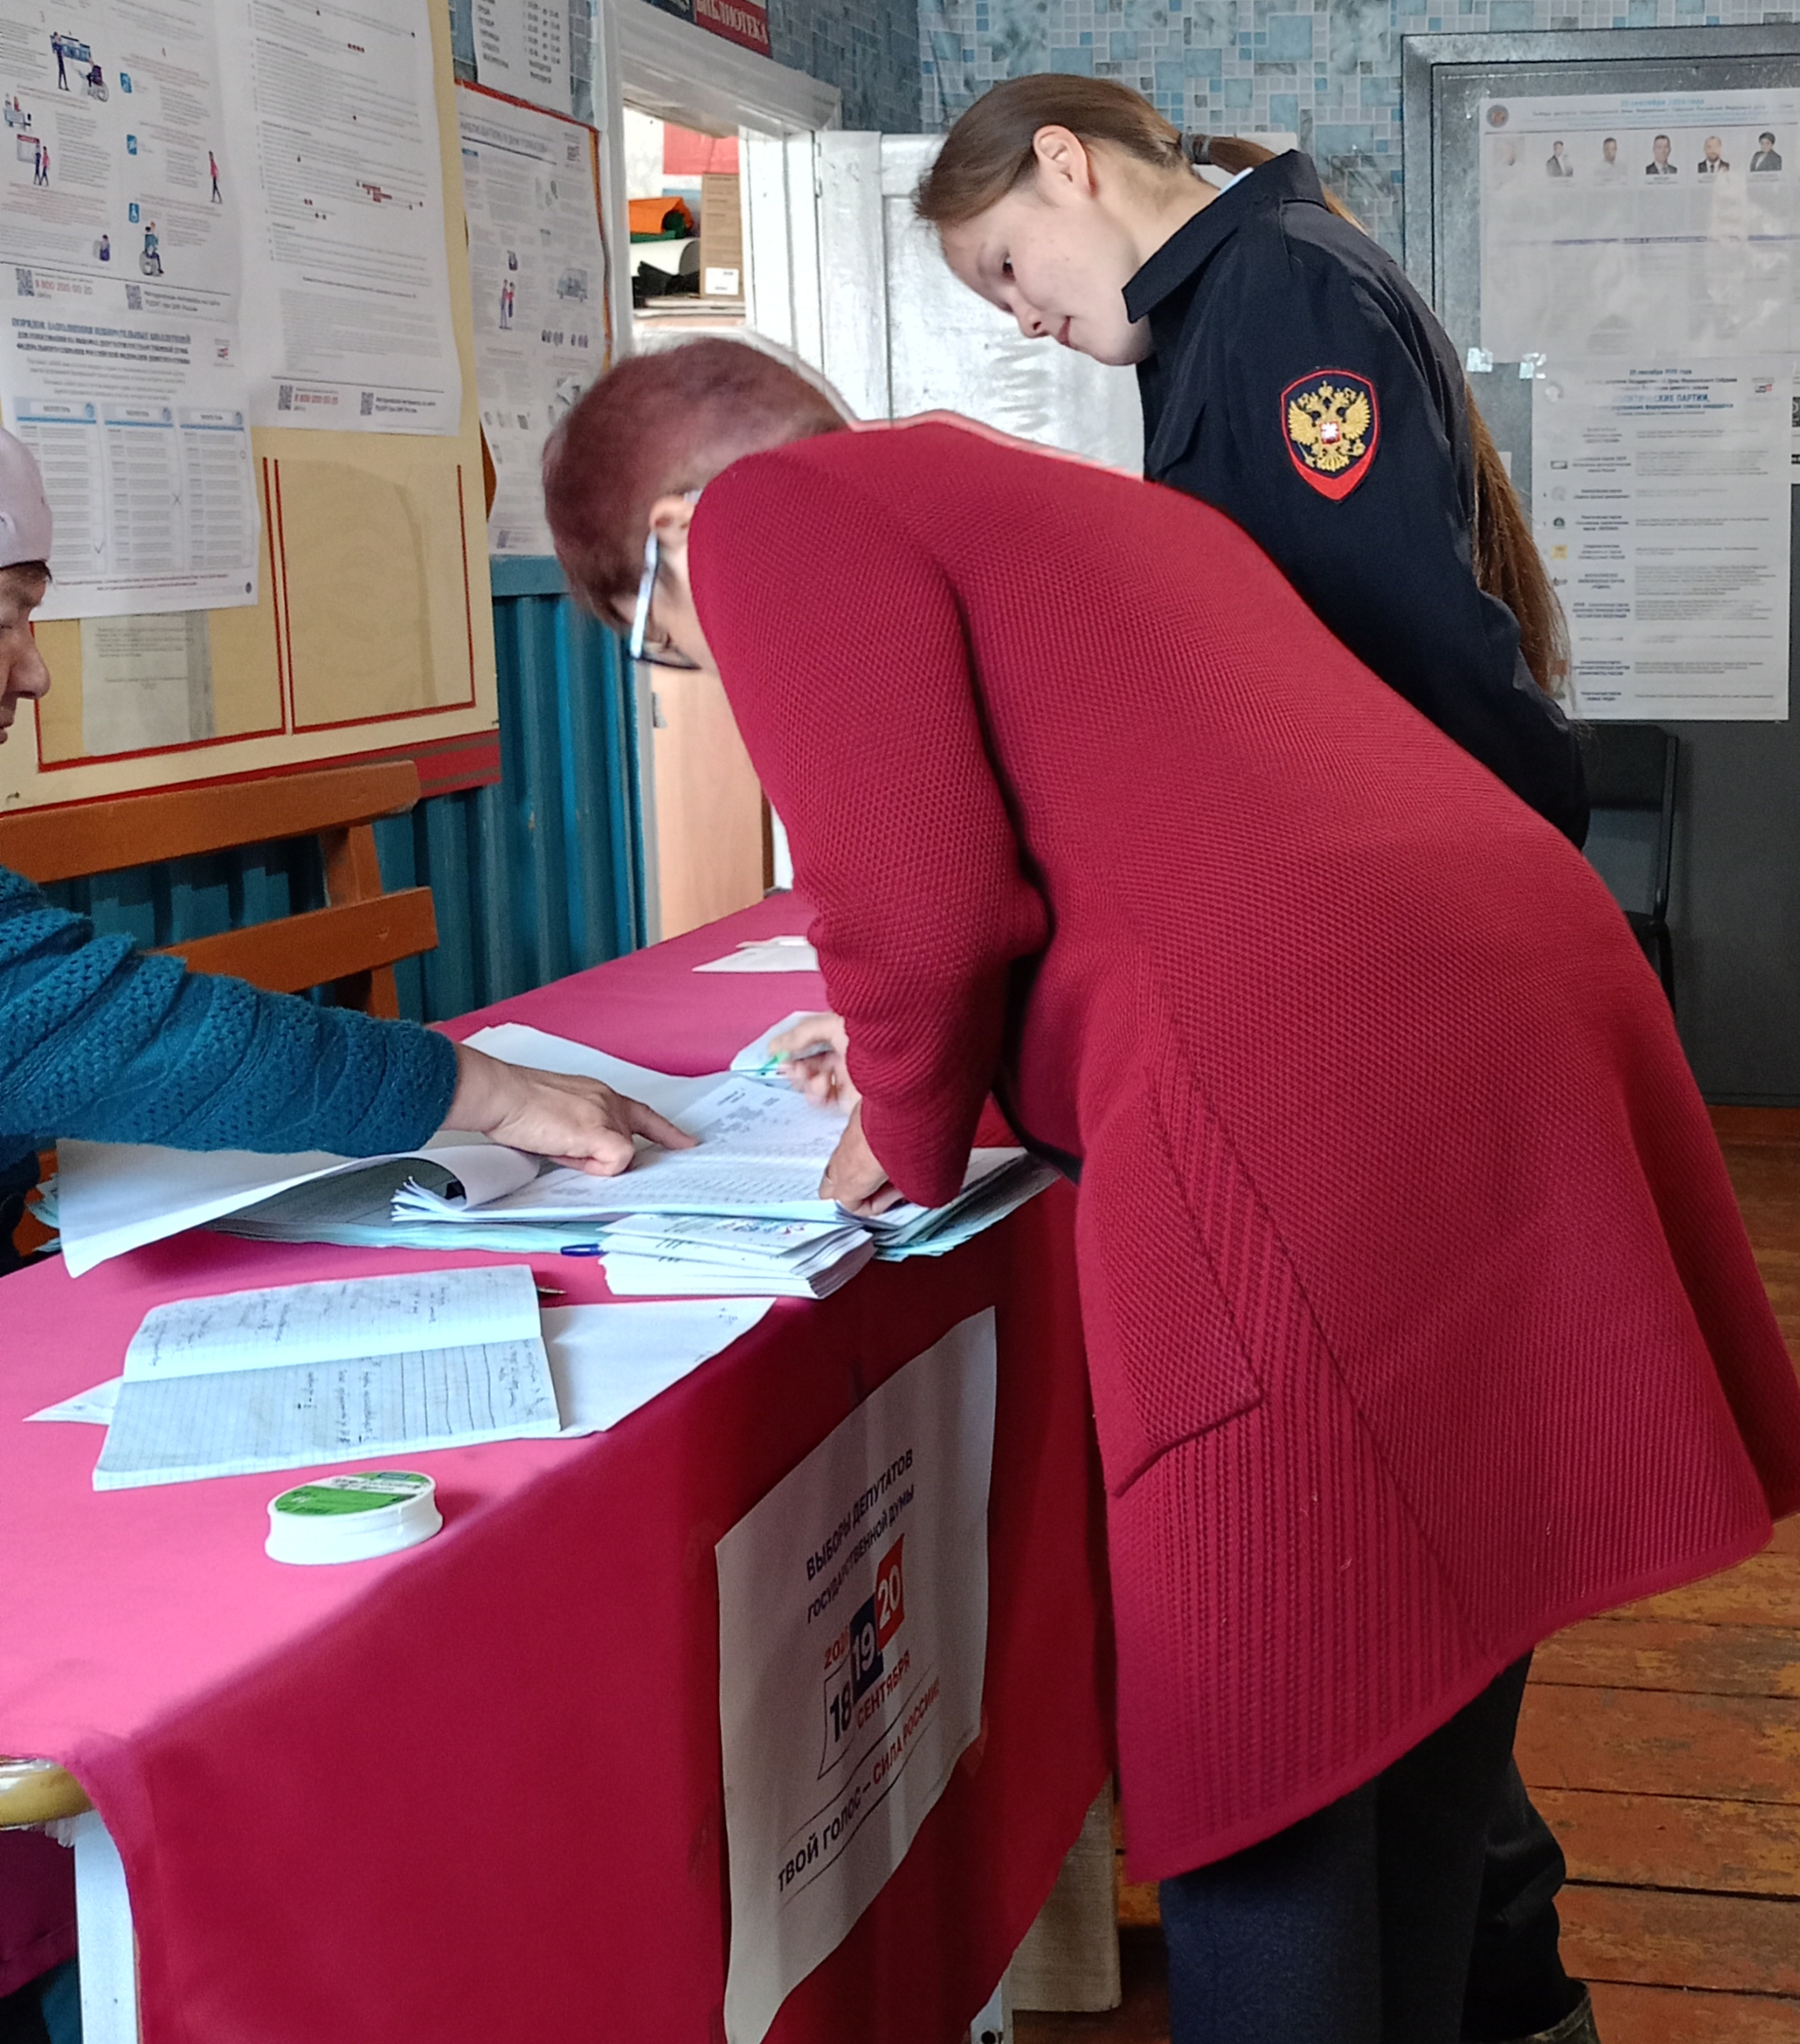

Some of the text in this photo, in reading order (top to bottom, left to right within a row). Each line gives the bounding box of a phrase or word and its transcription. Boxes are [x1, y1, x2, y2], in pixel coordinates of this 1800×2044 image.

[806, 1448, 912, 1582] ВЫБОРЫ ДЕПУТАТОВ
[807, 1484, 914, 1624] ГОСУДАРСТВЕННОЙ ДУМЫ
[852, 1622, 875, 1681] 19
[878, 1565, 901, 1631] 20
[830, 1650, 910, 1743] 18 СЕНТЯБРЯ
[777, 1832, 819, 1893] ТВОЙ
[823, 1786, 862, 1850] ГОЛОС
[872, 1736, 903, 1785] СИЛА
